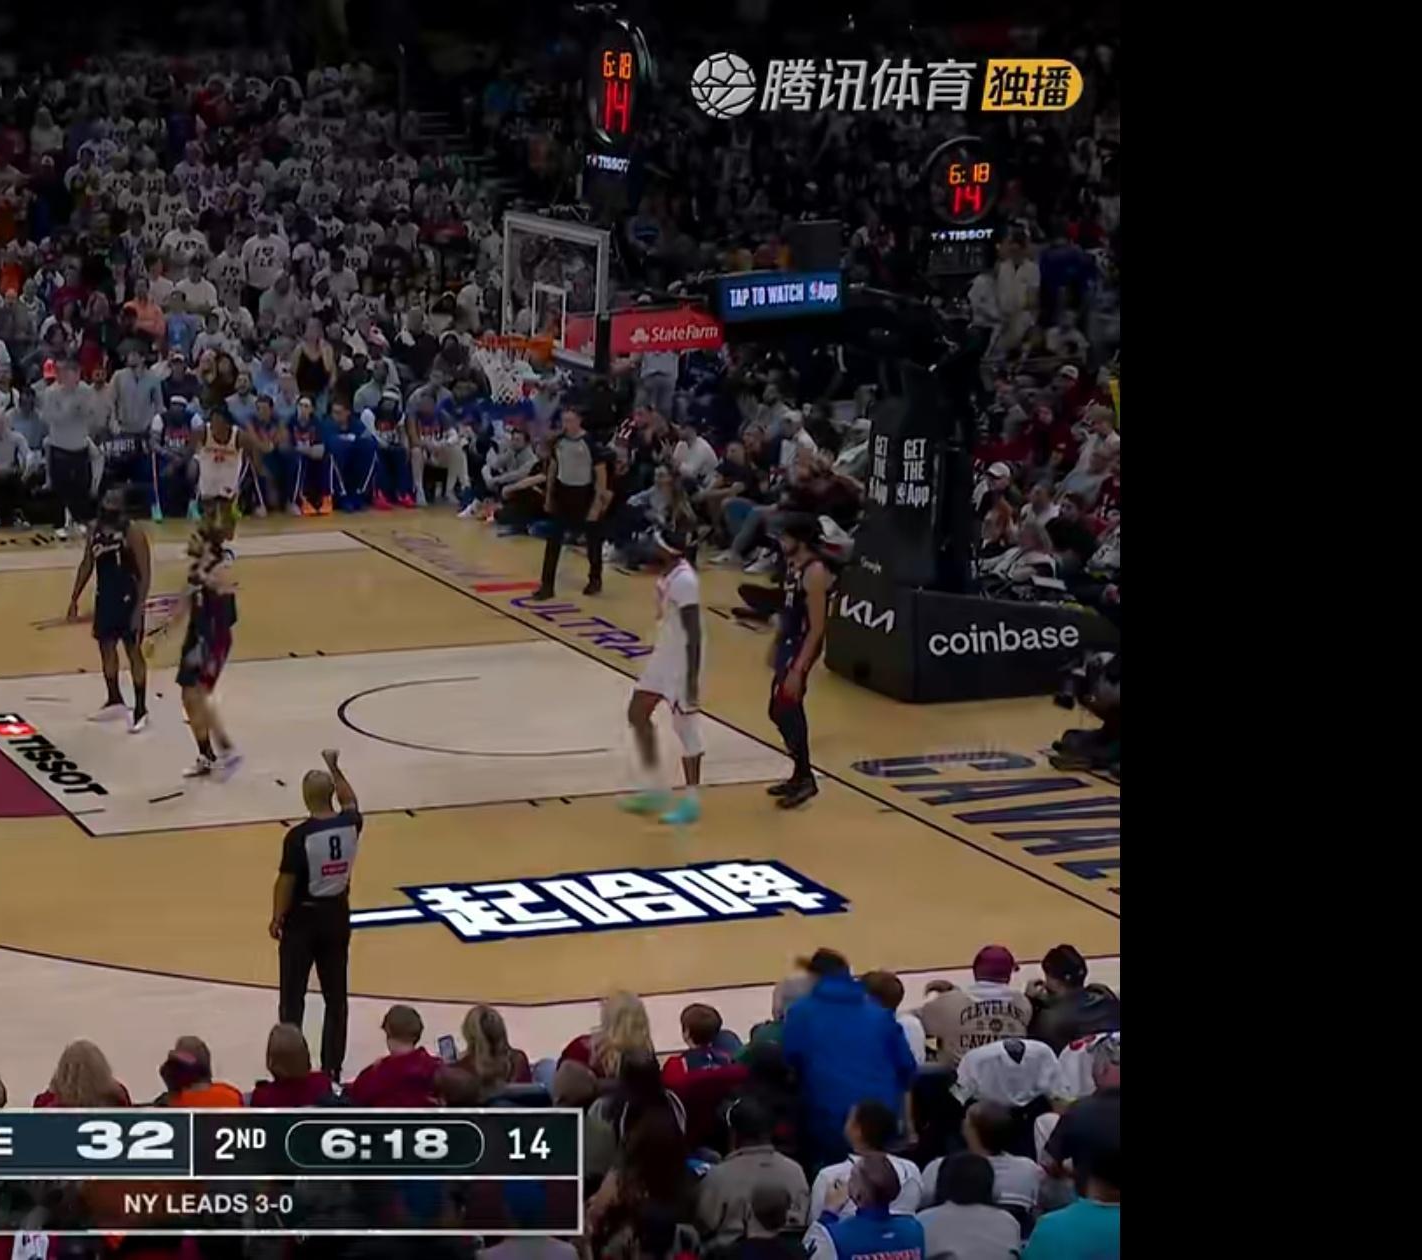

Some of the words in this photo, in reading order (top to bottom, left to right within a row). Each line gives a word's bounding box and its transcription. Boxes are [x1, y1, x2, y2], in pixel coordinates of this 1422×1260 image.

[604, 51, 633, 79] 6:18
[604, 80, 630, 134] 14
[948, 162, 991, 185] 6:18
[953, 185, 984, 217] 14
[729, 287, 750, 308] TAP
[751, 285, 766, 306] TO
[767, 282, 805, 304] WATCH
[904, 437, 928, 460] GET
[903, 460, 926, 482] THE
[906, 482, 930, 508] App
[510, 596, 655, 660] ULTRA
[928, 621, 1080, 657] coinbase
[8, 734, 108, 796] TISSOT
[329, 835, 342, 860] 8
[349, 862, 826, 937] 一起哈啤
